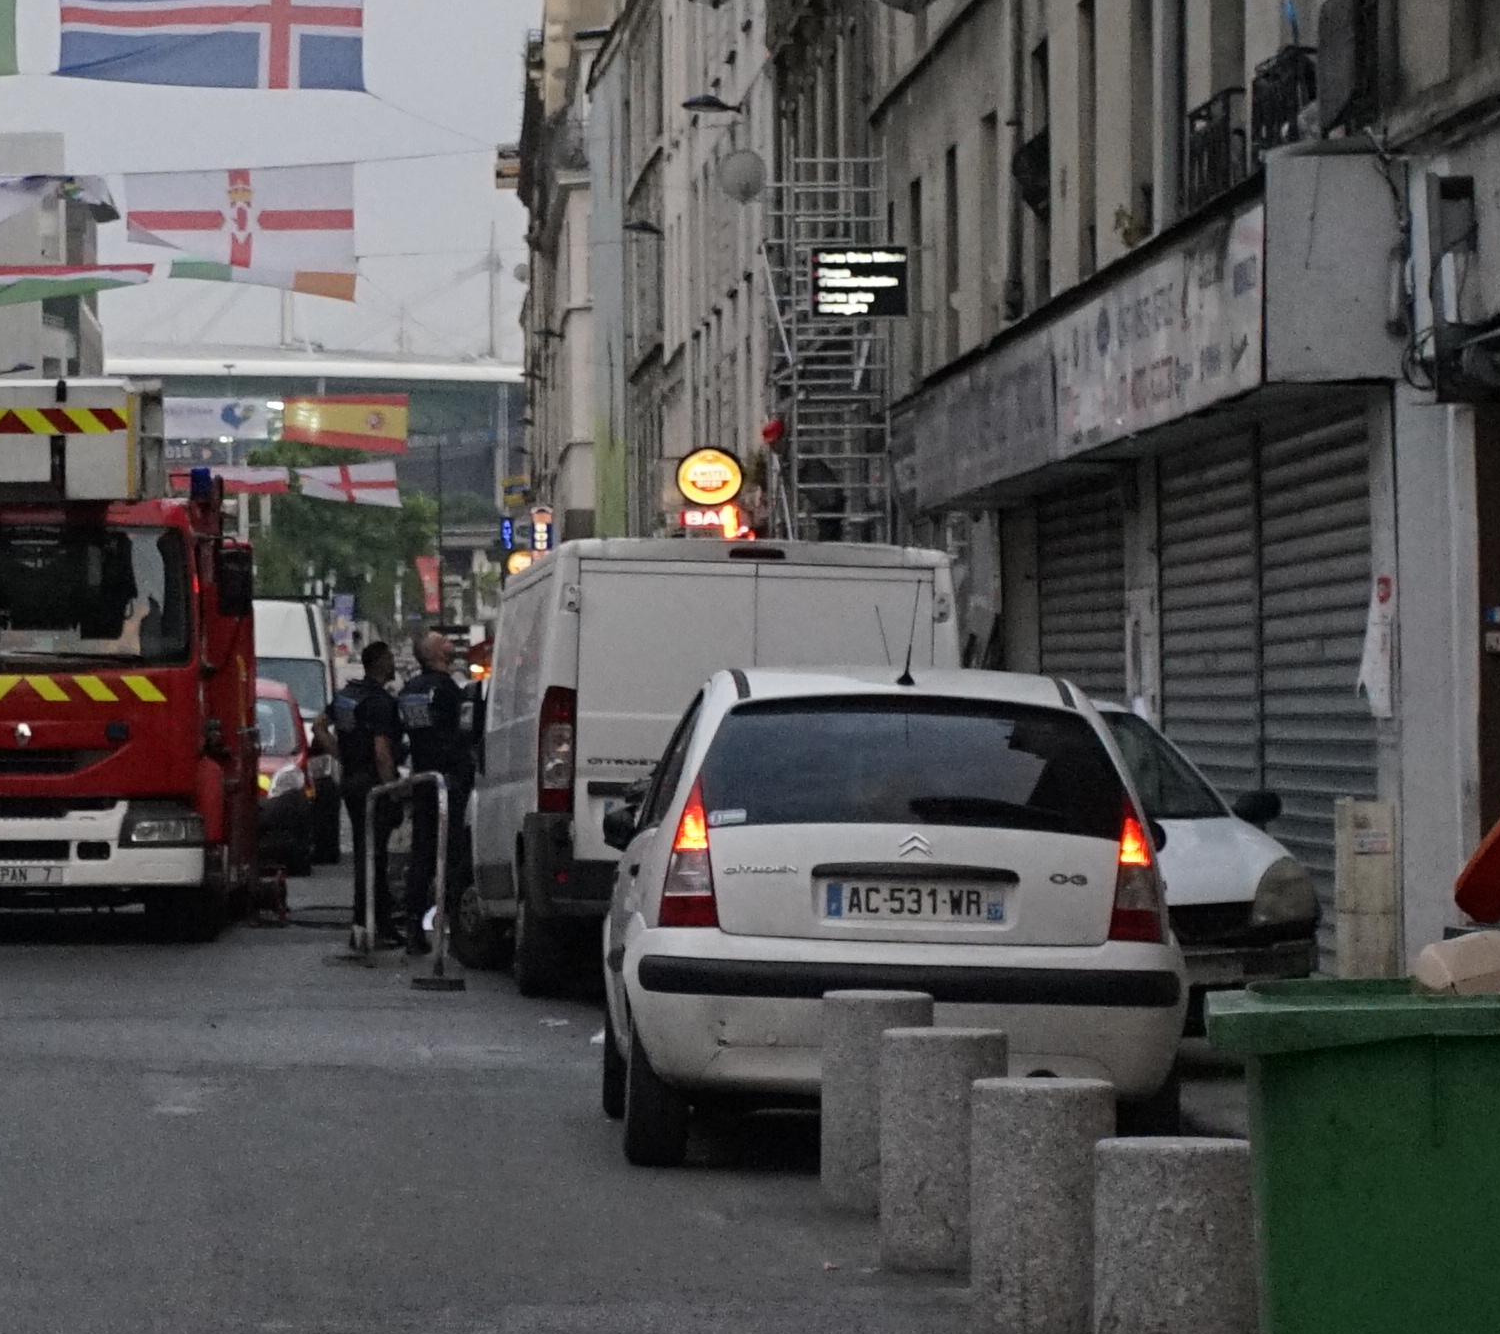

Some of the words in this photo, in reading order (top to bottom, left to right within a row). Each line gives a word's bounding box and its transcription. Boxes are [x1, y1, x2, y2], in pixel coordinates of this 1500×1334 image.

[684, 510, 737, 526] BA
[43, 867, 52, 882] 7
[848, 887, 982, 916] AC-531-WR
